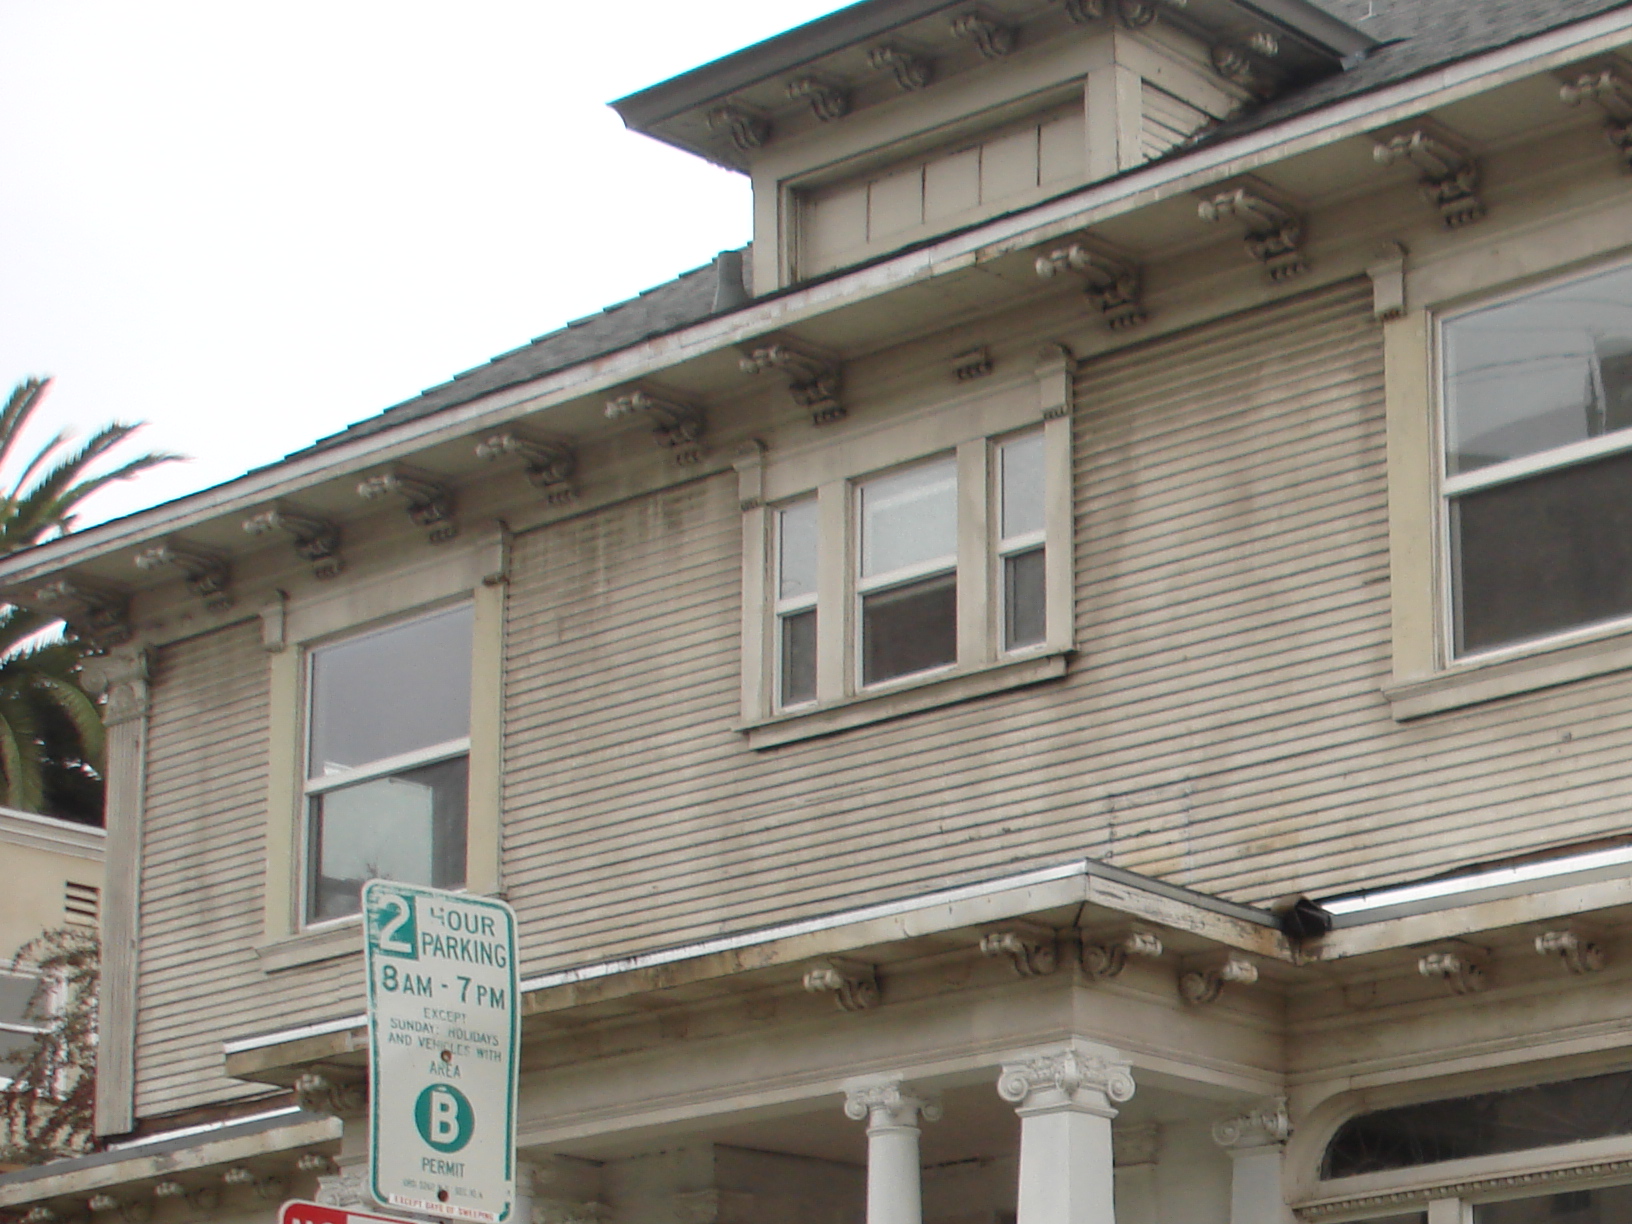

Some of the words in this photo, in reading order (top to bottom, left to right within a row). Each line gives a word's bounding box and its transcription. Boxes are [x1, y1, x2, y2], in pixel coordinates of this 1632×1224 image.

[379, 892, 411, 954] 2
[422, 932, 507, 969] PARKING
[423, 1007, 467, 1023] EXCEPT
[388, 1032, 412, 1047] AND
[476, 1048, 502, 1062] WITH
[448, 1028, 500, 1046] HOLIDAYS
[429, 1061, 461, 1078] AREA
[431, 1091, 459, 1144] B
[422, 1157, 466, 1178] PERMIT
